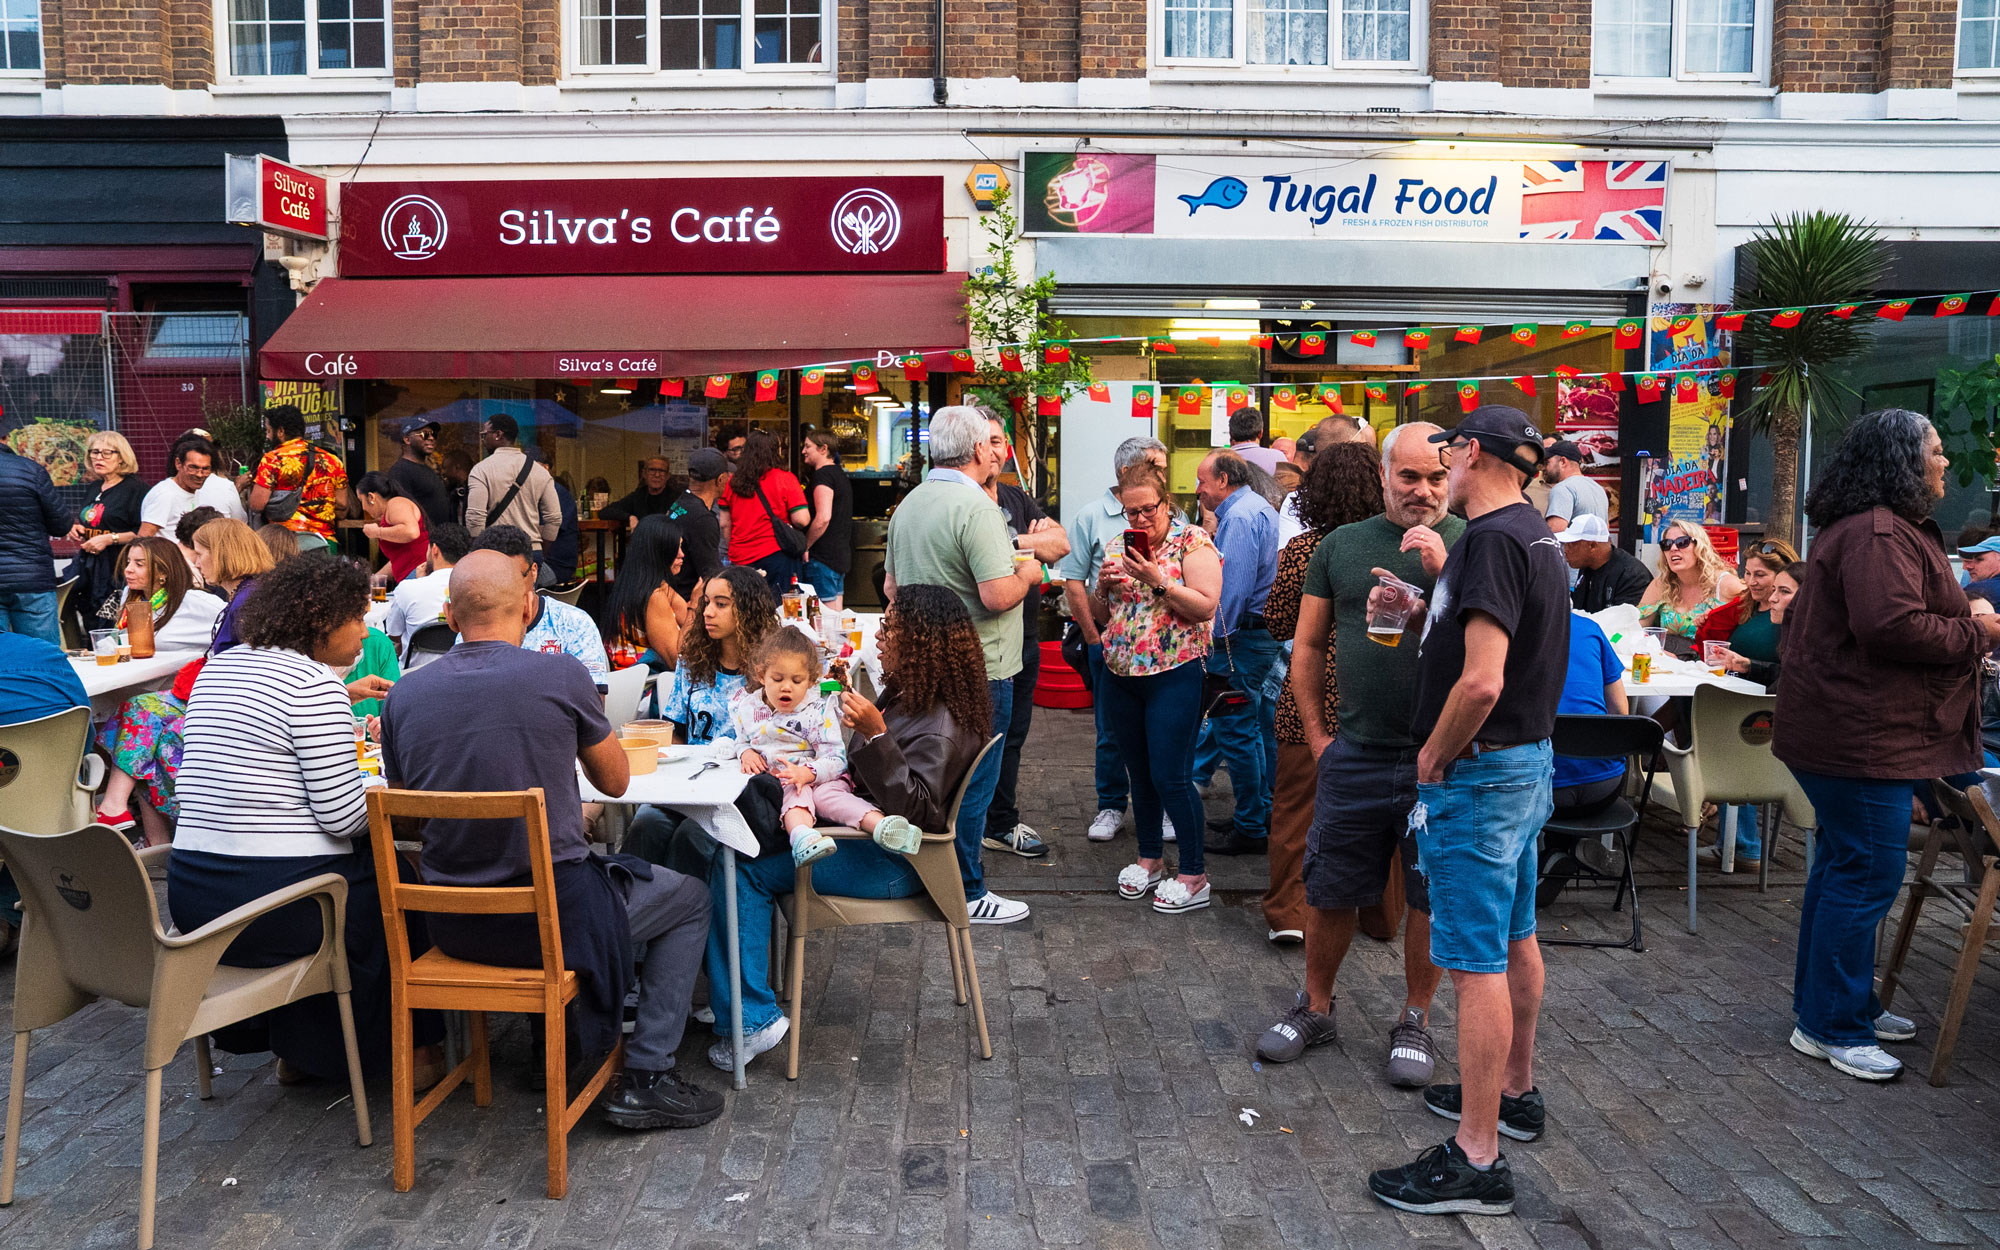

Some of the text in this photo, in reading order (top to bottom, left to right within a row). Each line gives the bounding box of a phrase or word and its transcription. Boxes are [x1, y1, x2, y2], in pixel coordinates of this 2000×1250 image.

[274, 171, 315, 200] Silva's
[977, 177, 996, 188] ADT
[281, 196, 311, 220] Café
[1262, 173, 1498, 226] Tugal Food
[499, 207, 780, 245] Silva's Café
[1342, 218, 1489, 228] FRESH & FROZEN FISH DISTRIBUTOR
[305, 352, 358, 376] Café
[1671, 347, 1705, 364] DIA DA
[559, 358, 657, 372] Silva's Café
[181, 383, 194, 392] 30
[1666, 460, 1699, 476] DIA DA
[1651, 467, 1717, 499] MADEIRA
[1391, 1047, 1427, 1063] PUMA
